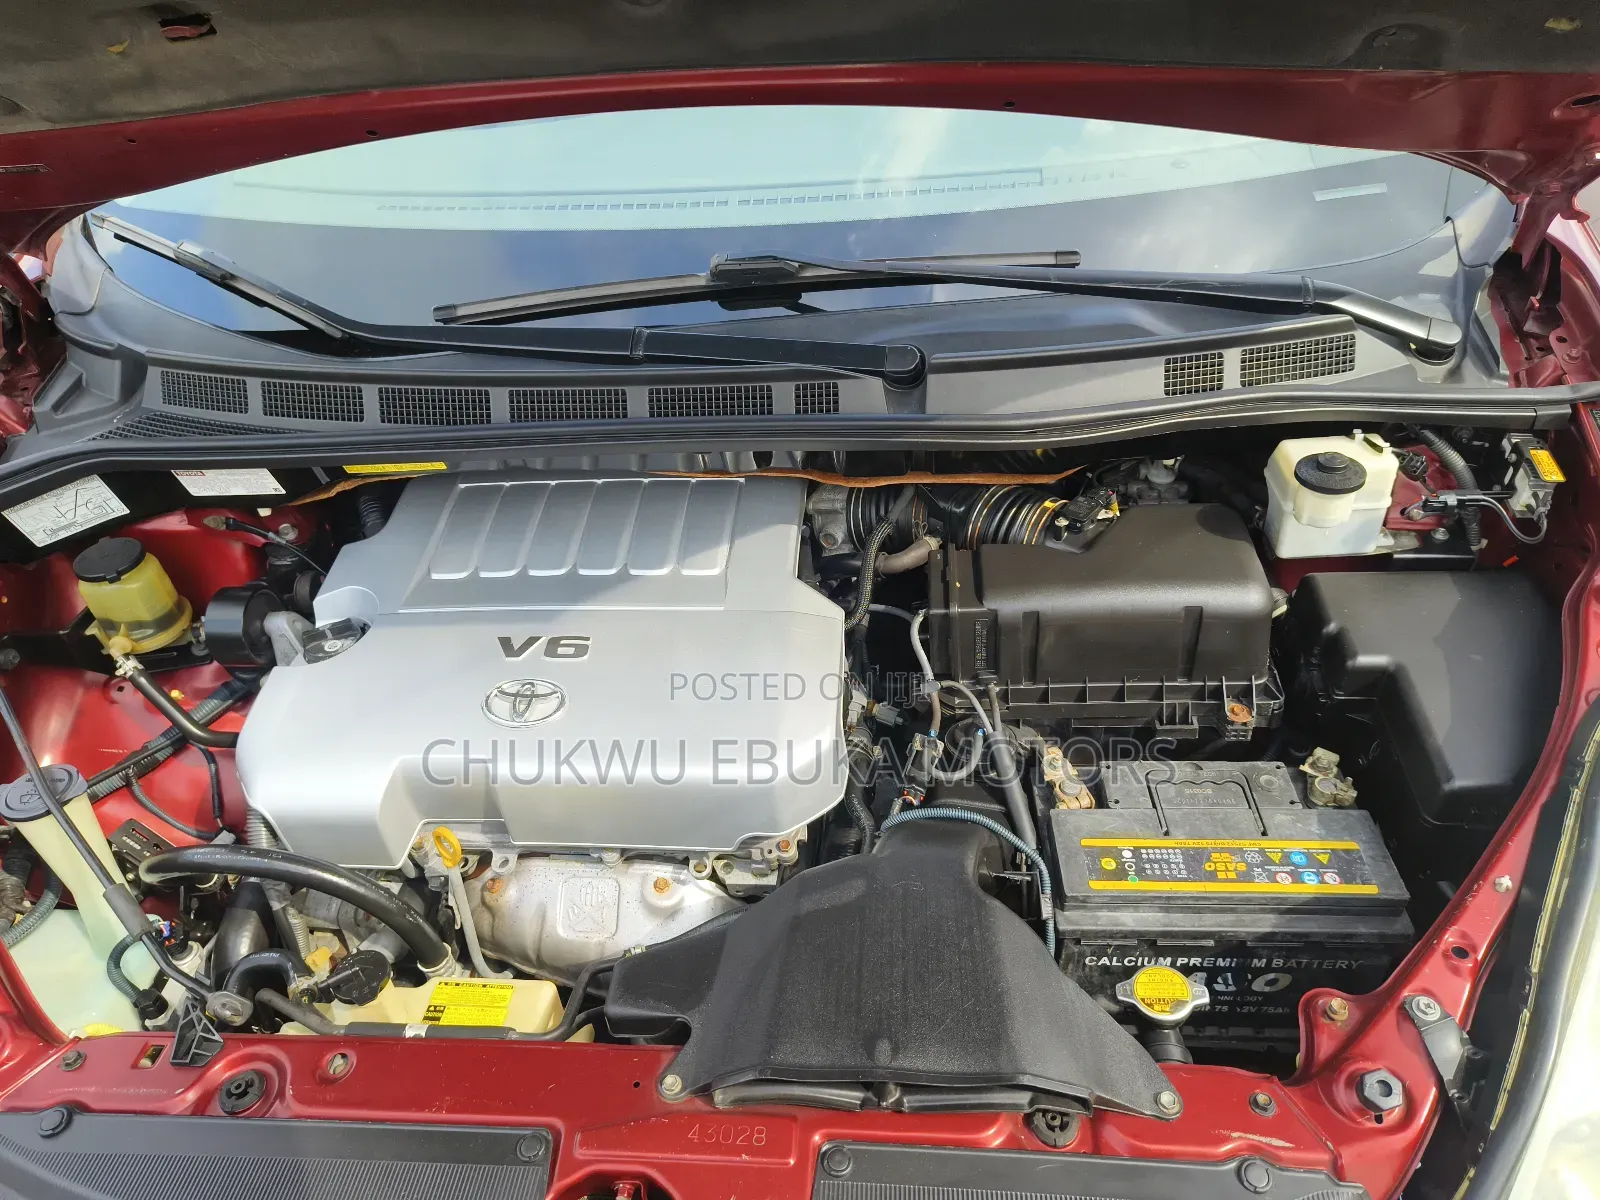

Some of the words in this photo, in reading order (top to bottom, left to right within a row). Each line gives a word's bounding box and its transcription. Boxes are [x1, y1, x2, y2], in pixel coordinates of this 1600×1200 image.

[497, 635, 592, 659] V6
[1204, 862, 1247, 872] SASO
[1084, 956, 1172, 967] CALCIUM
[1176, 957, 1267, 968] PREMIM
[1271, 957, 1364, 970] BATTERY
[687, 1123, 767, 1146] 43028
